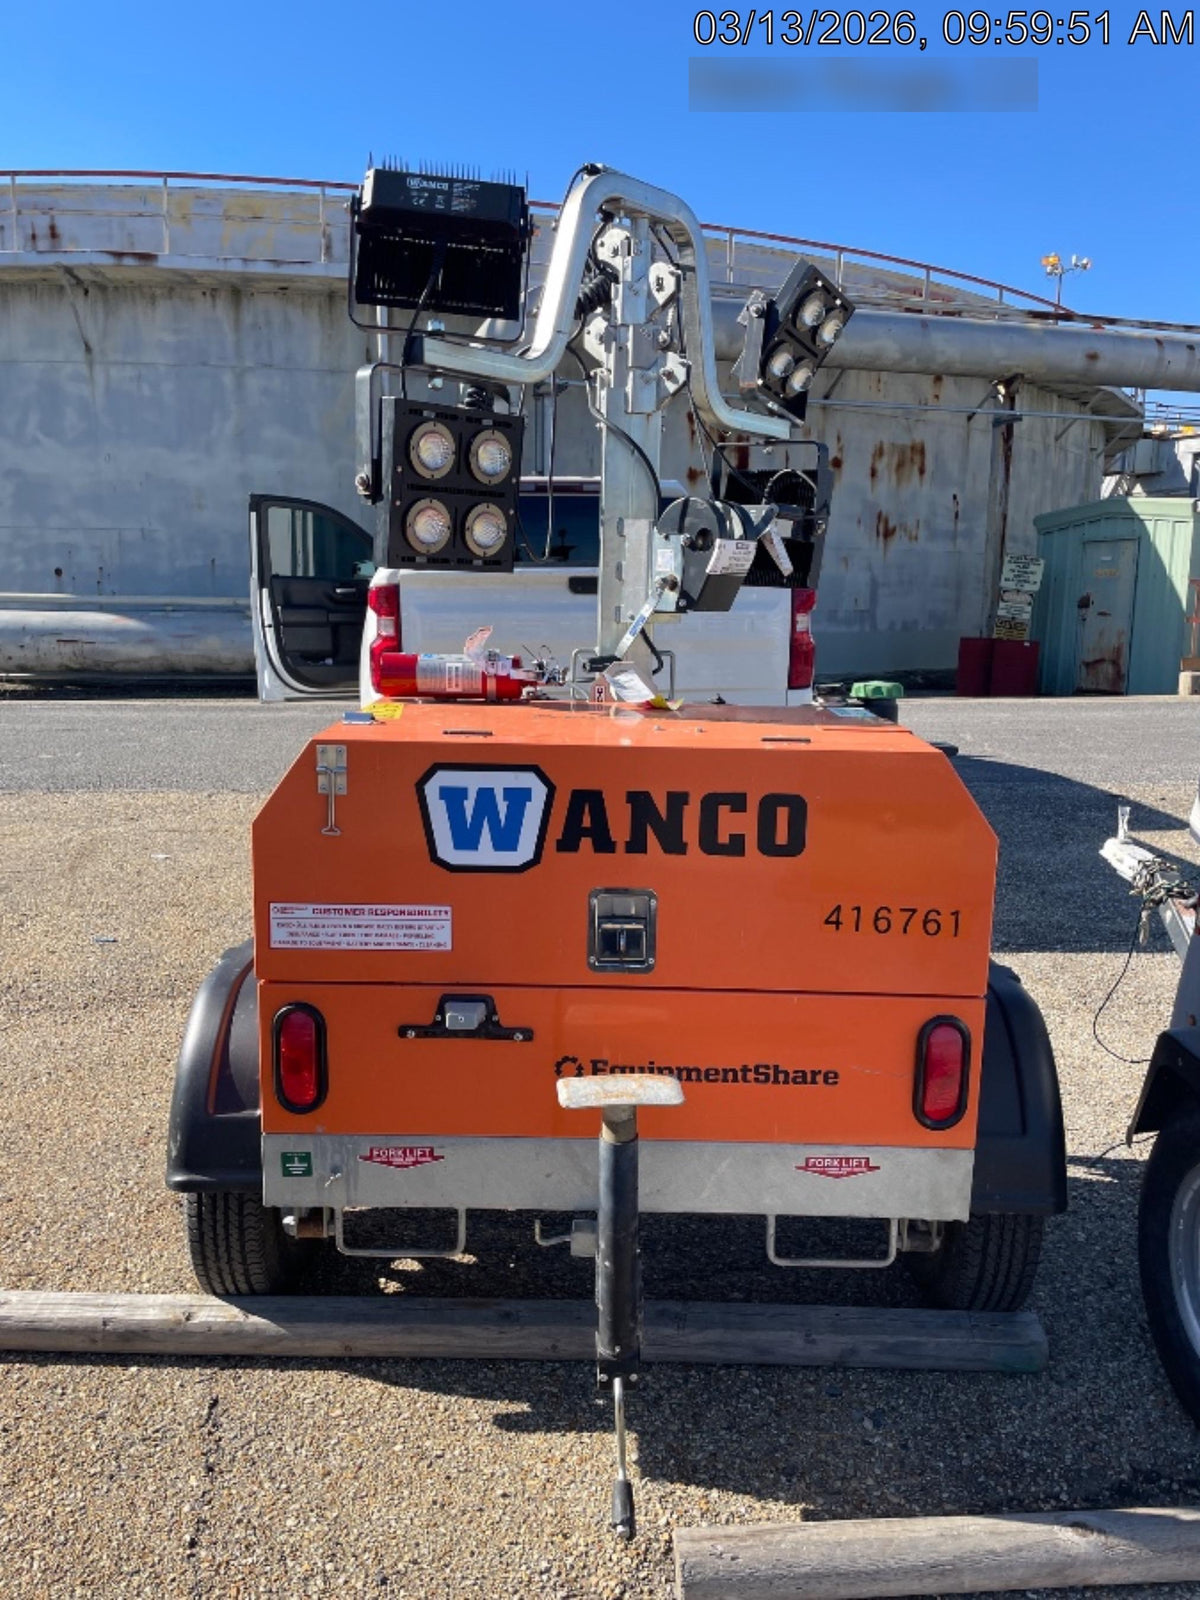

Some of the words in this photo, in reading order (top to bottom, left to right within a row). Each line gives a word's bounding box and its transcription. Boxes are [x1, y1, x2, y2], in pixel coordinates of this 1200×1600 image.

[438, 786, 808, 858] WANCO
[312, 907, 365, 917] CUSTOMER
[824, 904, 960, 937] 416761
[372, 1148, 403, 1157] FORK
[406, 1148, 430, 1157] LIFT
[808, 1158, 840, 1167] FORK
[842, 1158, 867, 1167] LIFT
